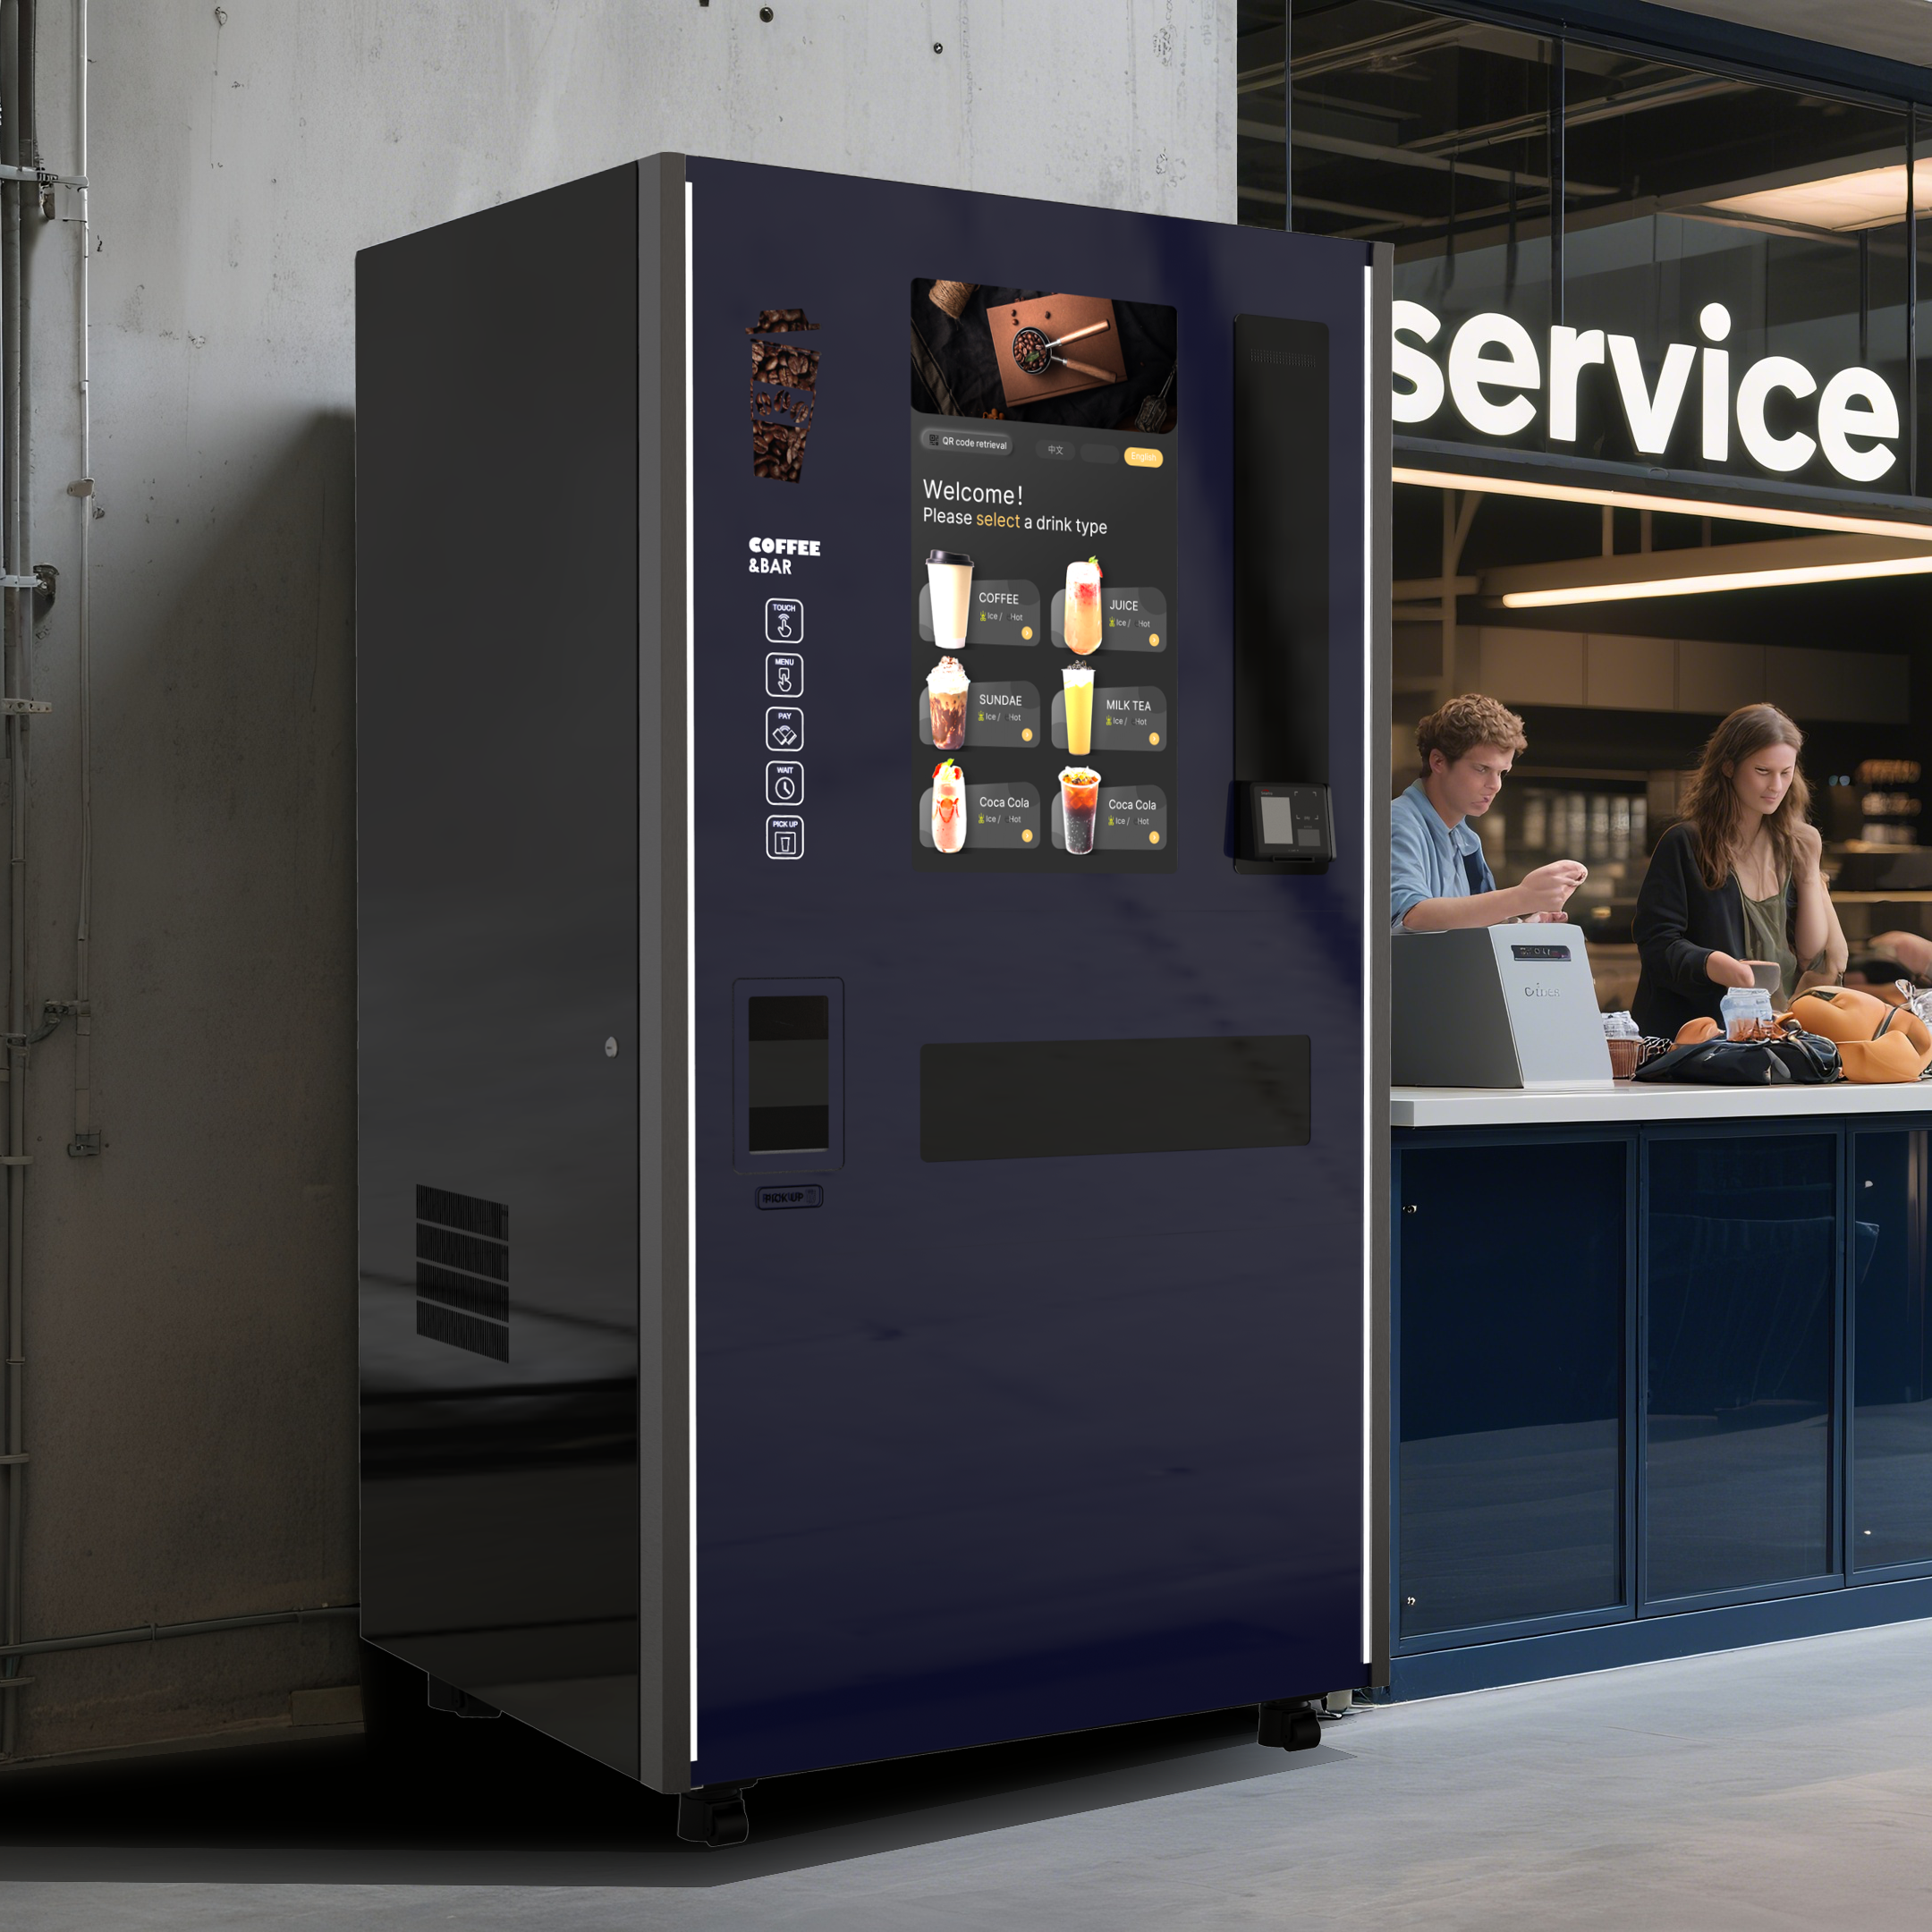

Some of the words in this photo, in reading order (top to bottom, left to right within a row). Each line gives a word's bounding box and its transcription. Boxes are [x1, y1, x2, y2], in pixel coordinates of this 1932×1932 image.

[1392, 300, 1900, 482] service
[943, 436, 953, 445] QR
[955, 438, 975, 447] code
[976, 440, 1007, 450] retrieval
[1048, 445, 1063, 455] 中文
[1131, 452, 1157, 462] English
[924, 507, 972, 525] Please
[977, 512, 1021, 529] select
[1024, 517, 1032, 530] a
[1037, 515, 1072, 531] drink
[1075, 519, 1107, 537] type
[749, 537, 820, 555] COFFEE
[749, 557, 792, 574] &BAR
[979, 592, 1019, 605] COFFEE
[773, 604, 796, 612] TOUCH
[1110, 599, 1138, 611] JUICE
[1139, 620, 1150, 628] Hot
[979, 694, 1021, 706] SUNDAE
[1106, 699, 1130, 710] MILK
[1132, 700, 1151, 711] TEA
[979, 796, 1005, 808] Coca
[1007, 797, 1030, 808] Cola
[1108, 799, 1133, 809] Coca
[1135, 800, 1157, 810] Cola
[773, 820, 787, 828] PICK
[789, 820, 799, 828] UP
